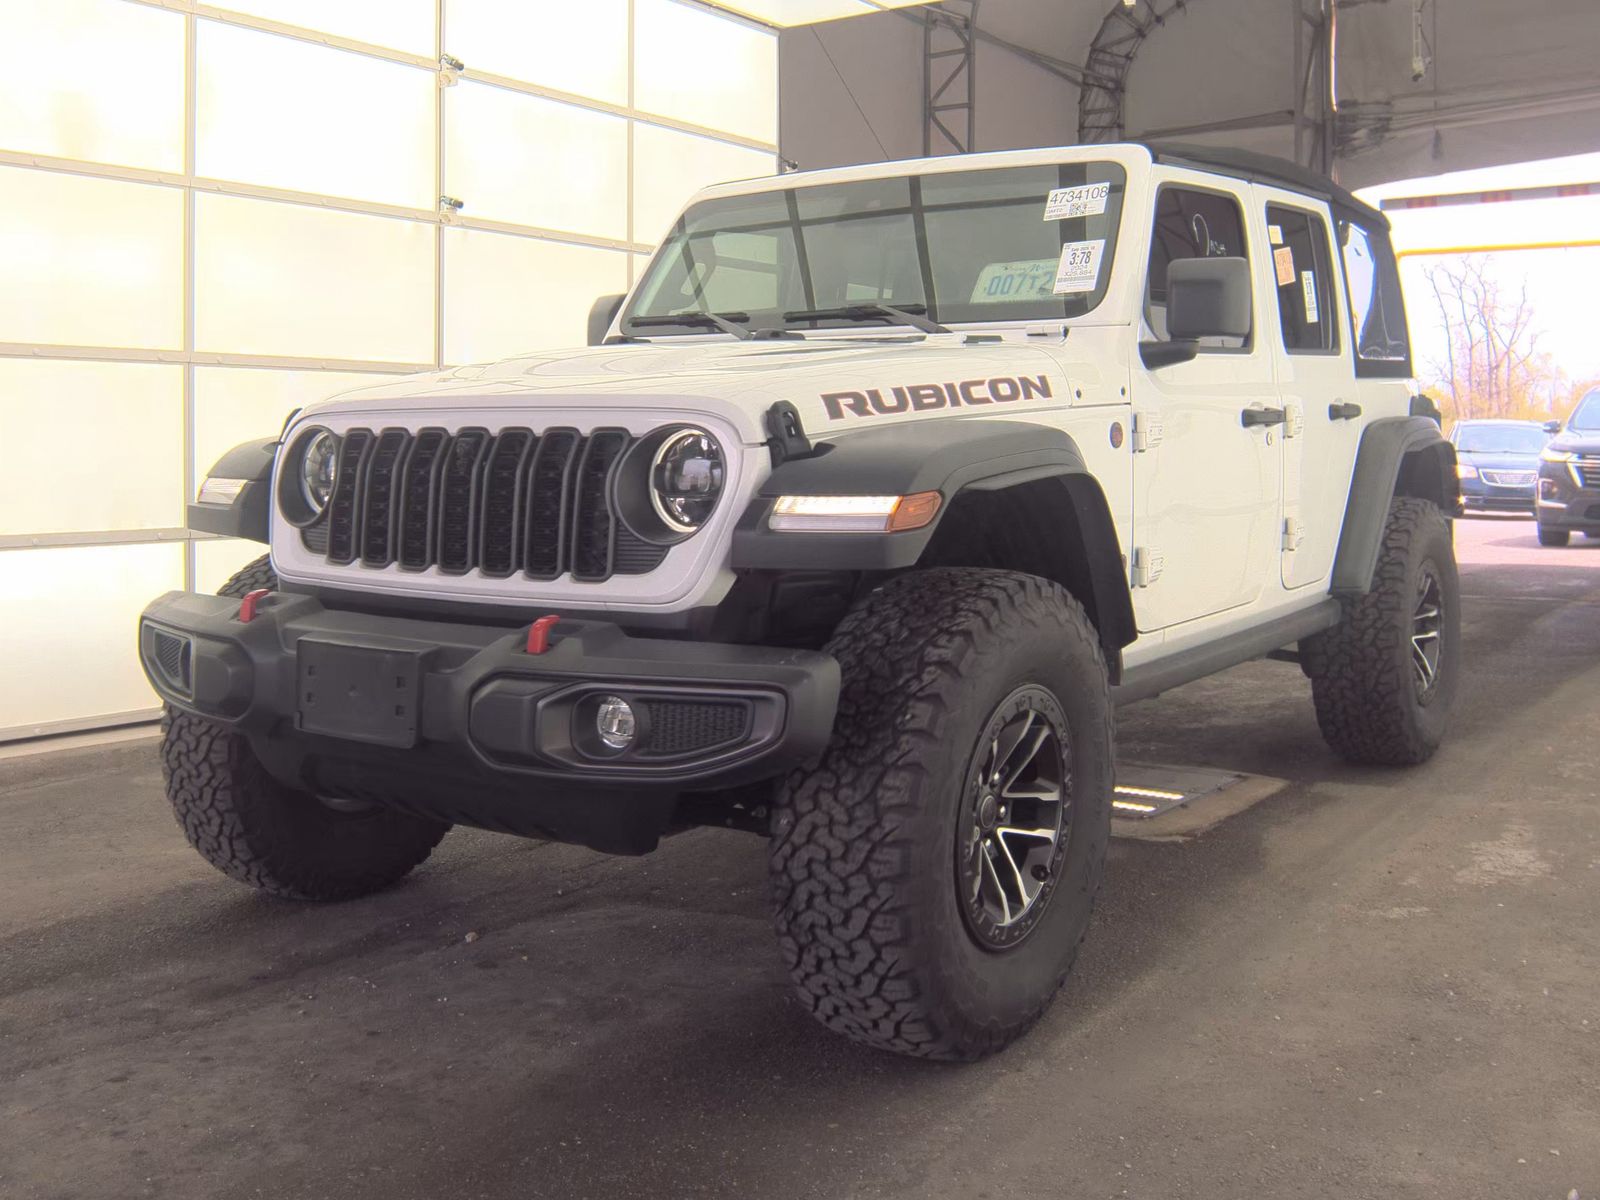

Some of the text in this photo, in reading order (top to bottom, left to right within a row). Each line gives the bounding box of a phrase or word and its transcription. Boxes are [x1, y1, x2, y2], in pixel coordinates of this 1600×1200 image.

[1050, 185, 1109, 205] 4734108
[1069, 250, 1092, 266] 3:78
[820, 374, 1053, 420] RUBICON
